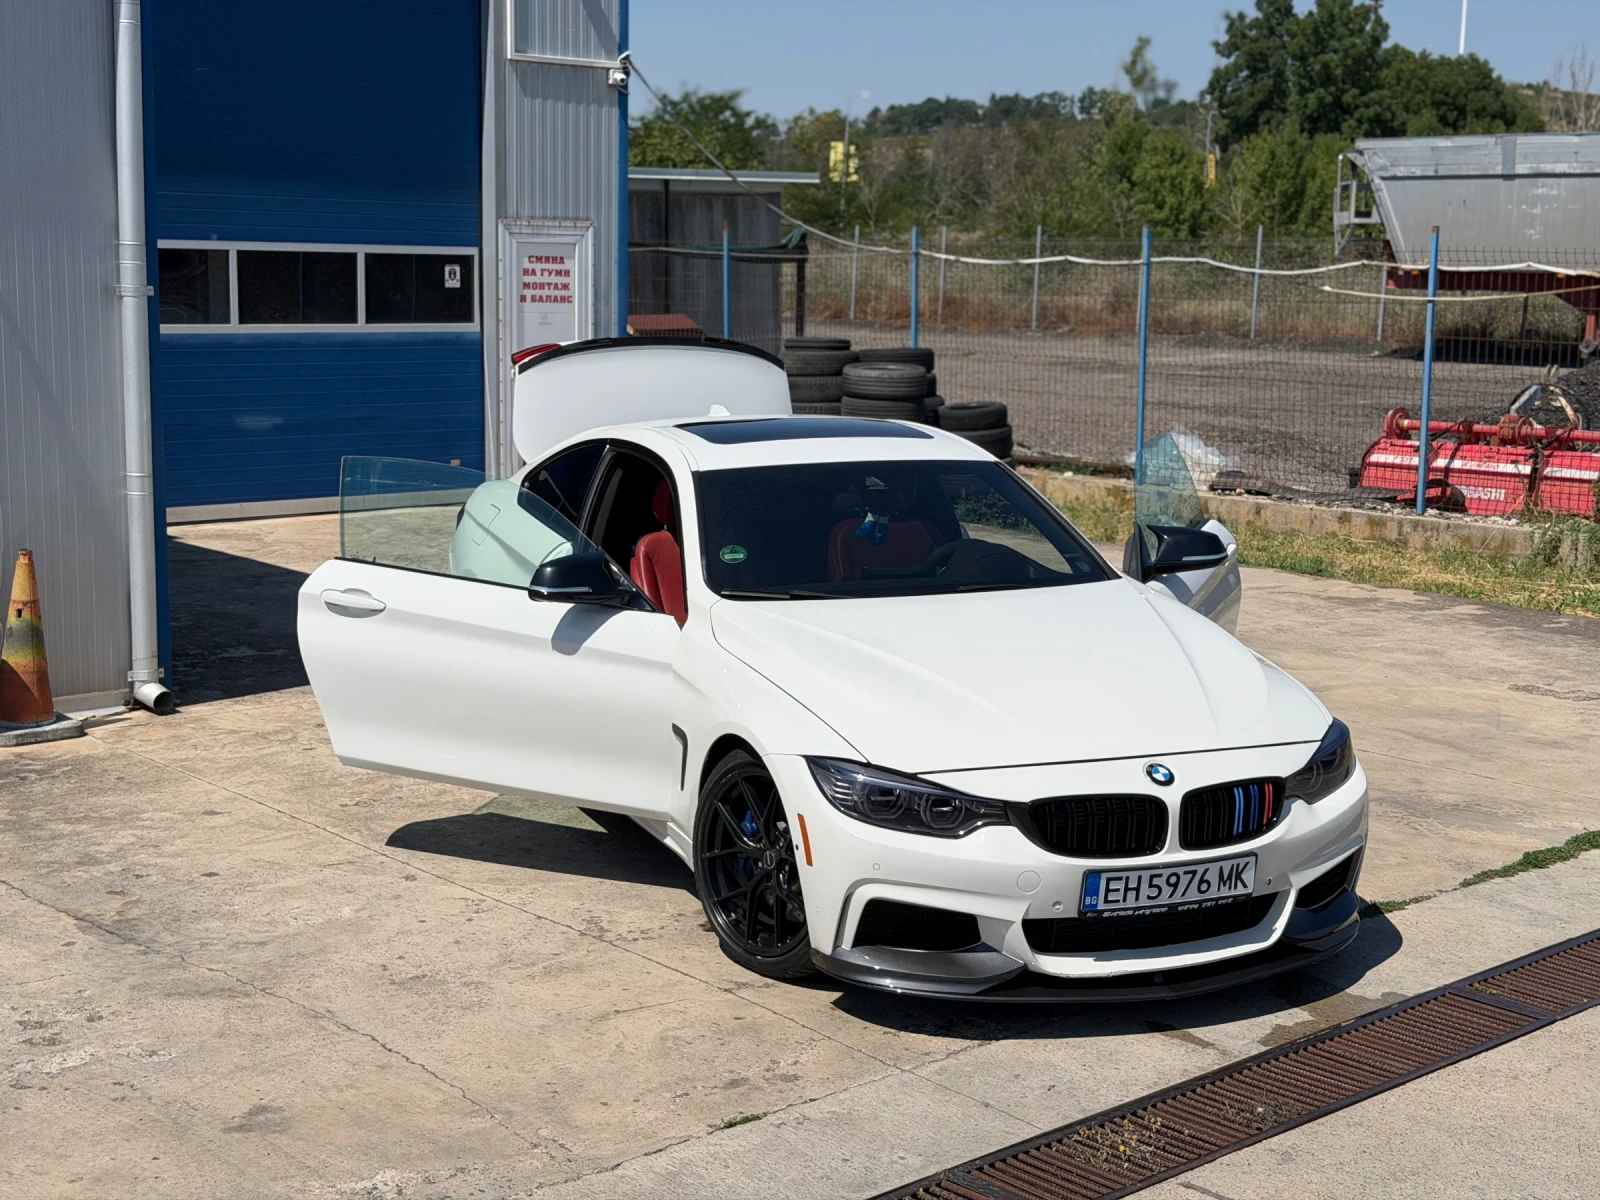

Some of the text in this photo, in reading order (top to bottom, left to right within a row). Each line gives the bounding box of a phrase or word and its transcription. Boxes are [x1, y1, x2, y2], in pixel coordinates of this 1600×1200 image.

[528, 255, 565, 264] СМЯНА
[522, 268, 537, 277] НА
[522, 282, 571, 291] МОНТАЖ
[530, 295, 573, 304] БАЛАНС
[1085, 896, 1098, 905] BG
